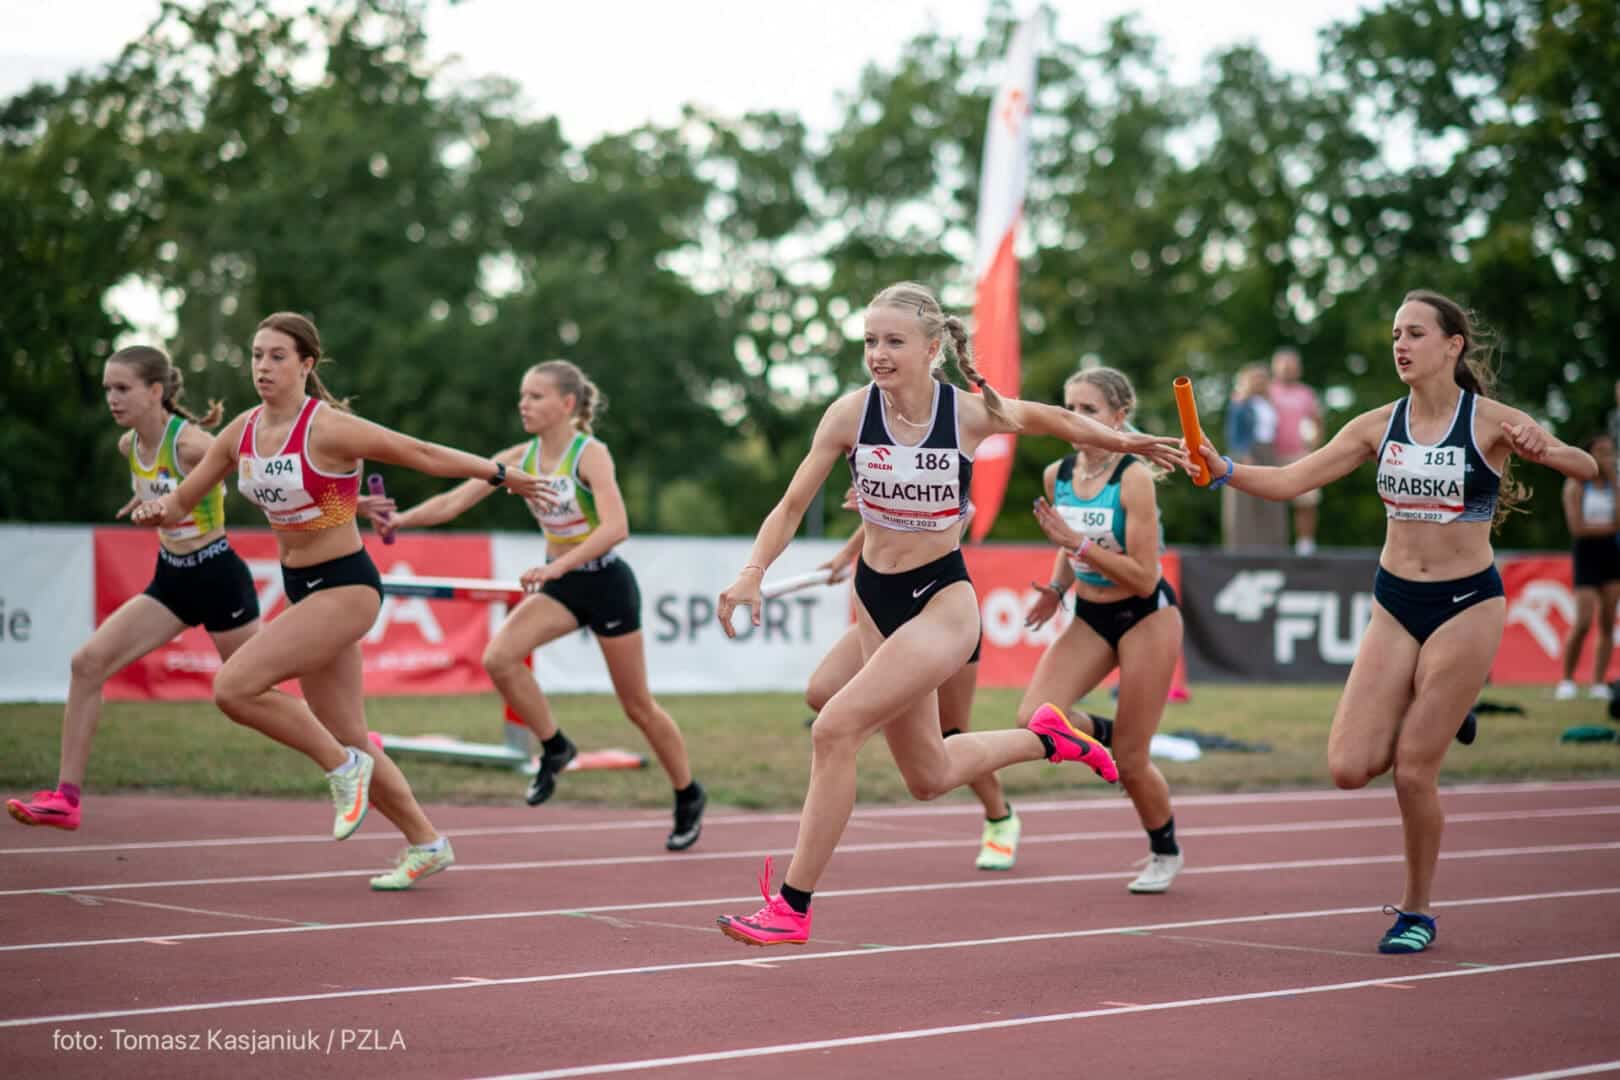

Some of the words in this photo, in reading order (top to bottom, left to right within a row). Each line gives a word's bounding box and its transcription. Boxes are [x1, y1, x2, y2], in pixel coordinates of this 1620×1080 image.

[867, 462, 893, 472] ORLEN
[914, 453, 950, 471] 186
[1424, 450, 1457, 467] 181
[265, 459, 293, 476] 494
[861, 478, 955, 503] SZLACHTA
[1378, 472, 1461, 498] HRABSKA
[253, 487, 288, 504] HOC
[197, 539, 228, 564] PRO
